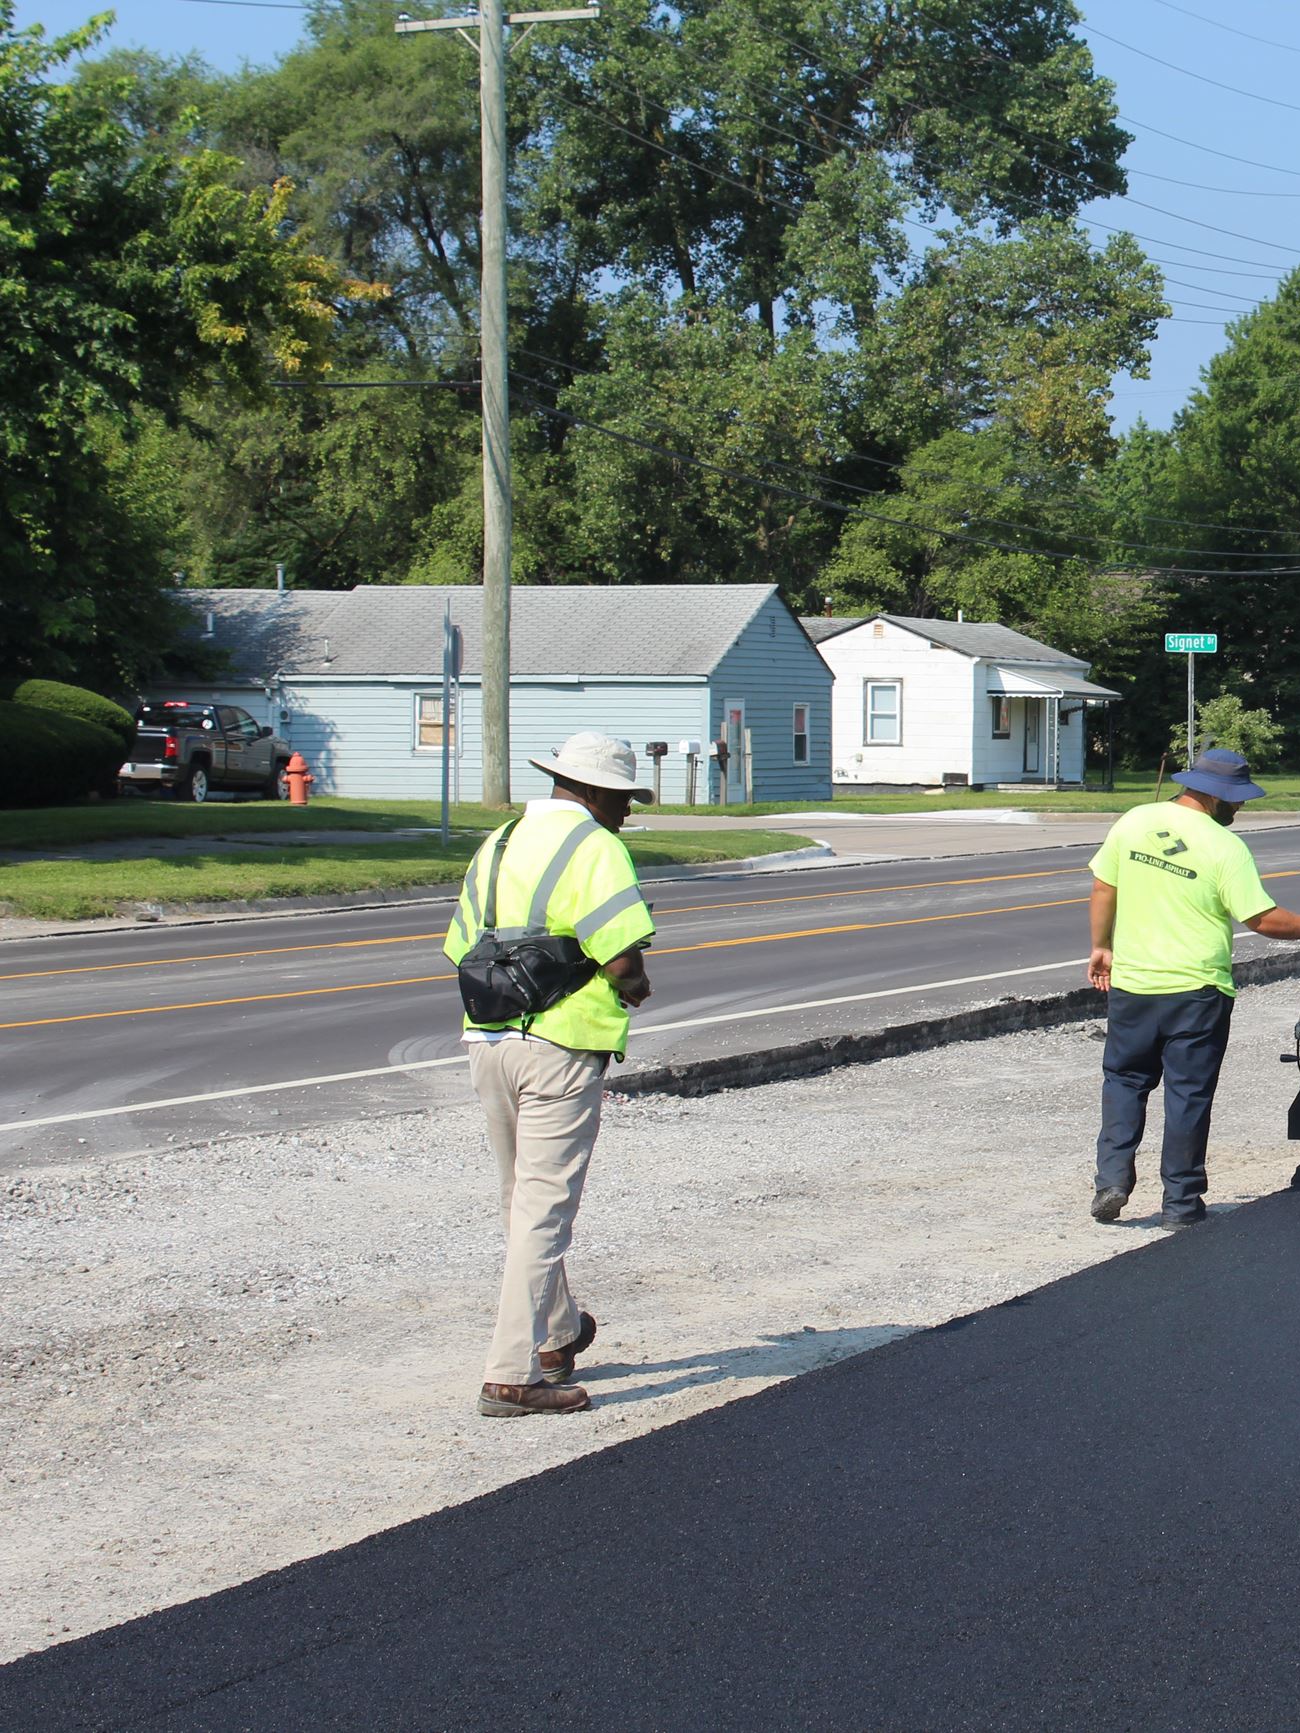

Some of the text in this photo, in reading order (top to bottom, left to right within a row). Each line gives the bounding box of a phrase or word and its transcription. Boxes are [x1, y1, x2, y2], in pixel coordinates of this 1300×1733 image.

[1168, 635, 1205, 651] Signet
[1134, 852, 1191, 877] PRO-LINE ASPHALT
